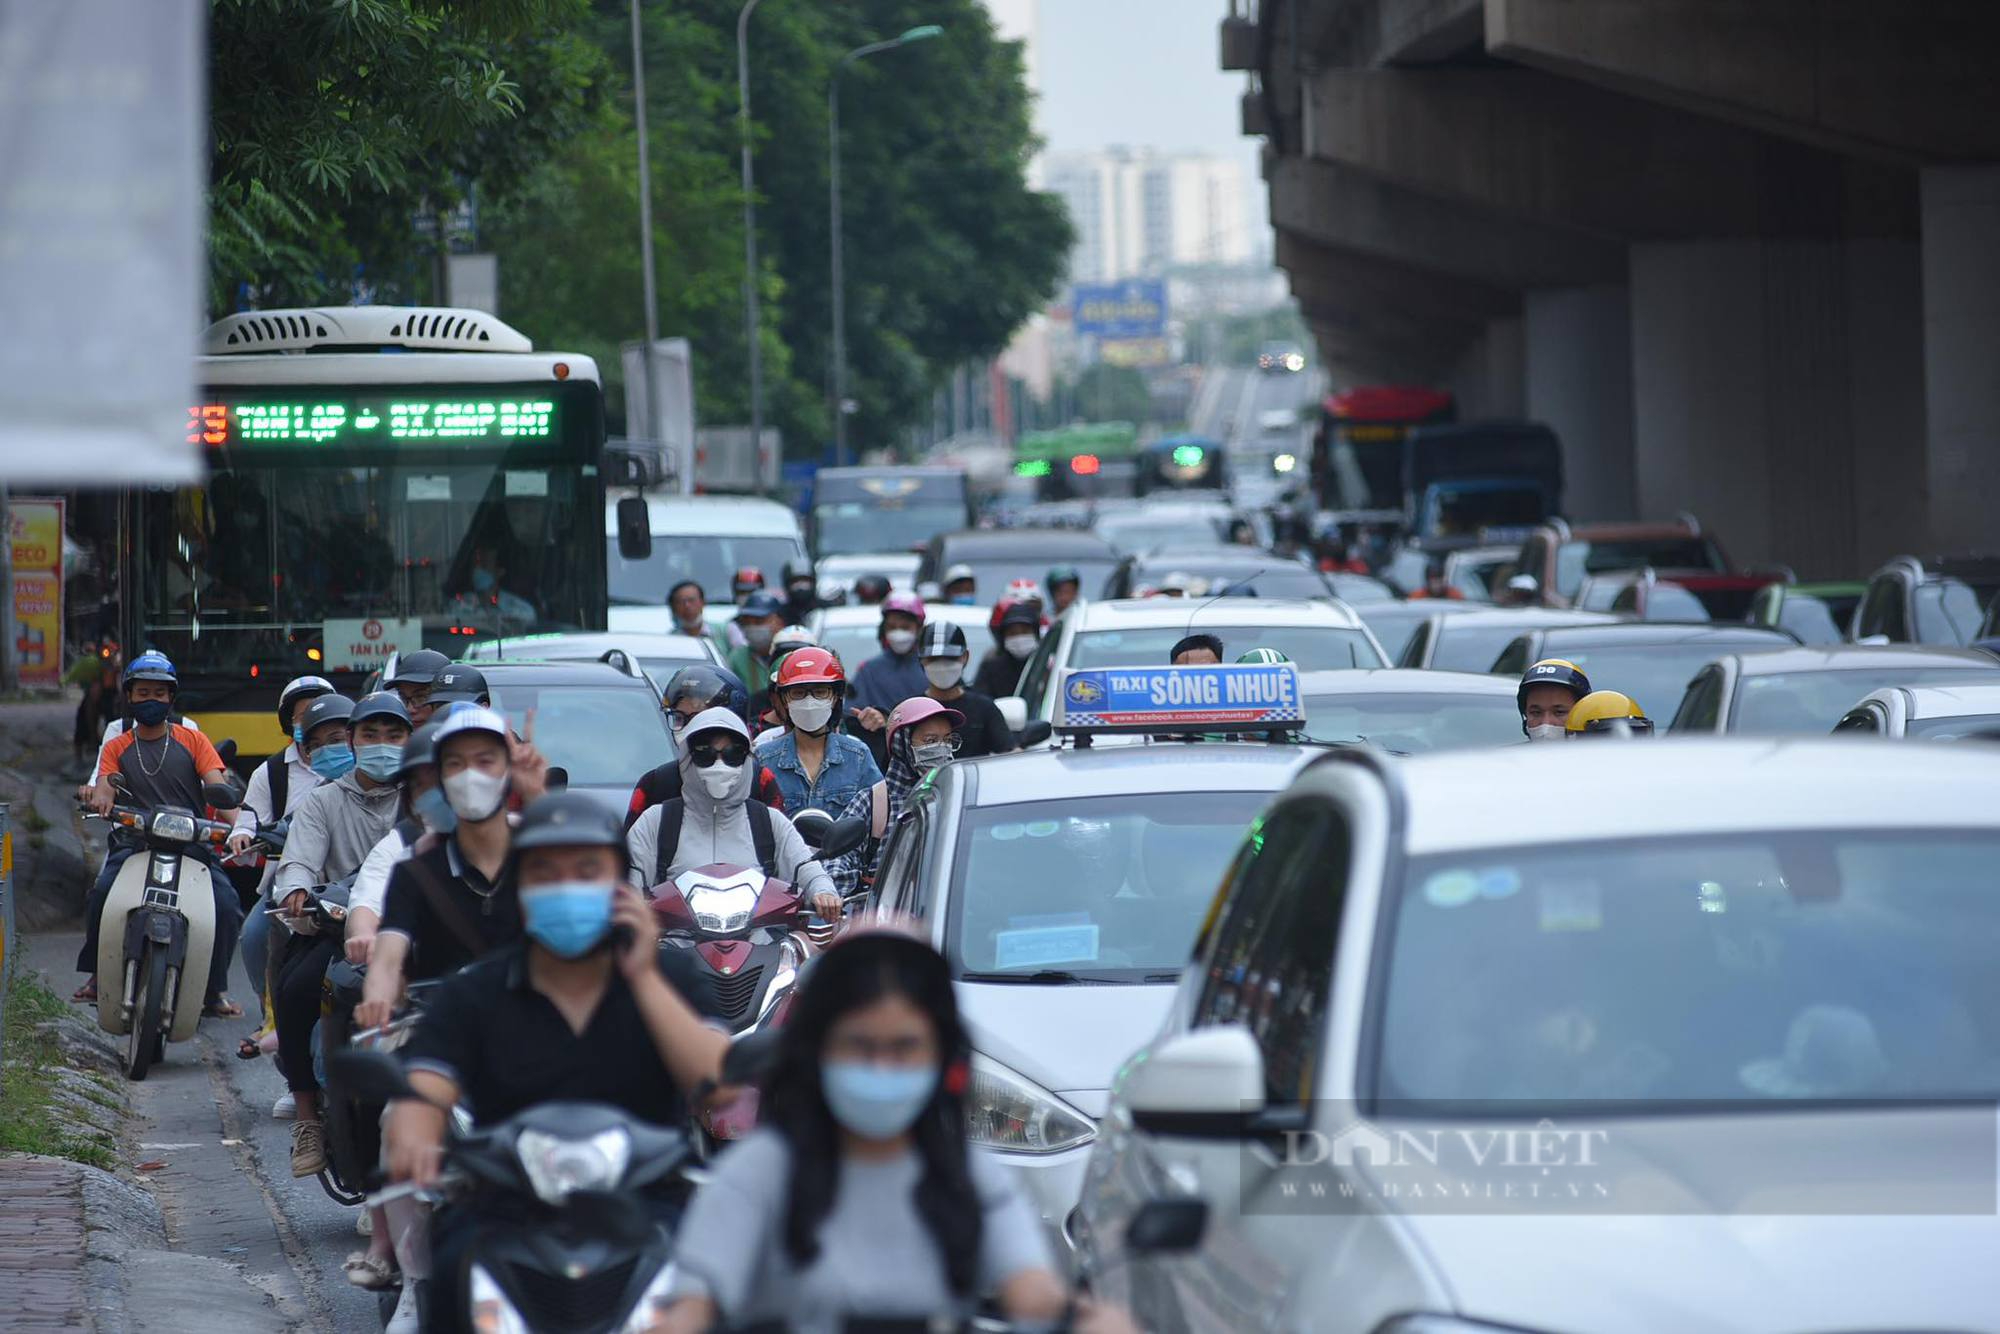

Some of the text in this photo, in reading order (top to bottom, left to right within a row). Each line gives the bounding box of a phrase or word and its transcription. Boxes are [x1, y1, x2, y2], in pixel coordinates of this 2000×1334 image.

[1110, 668, 1293, 710] TAXI SÔNG NHUỆ
